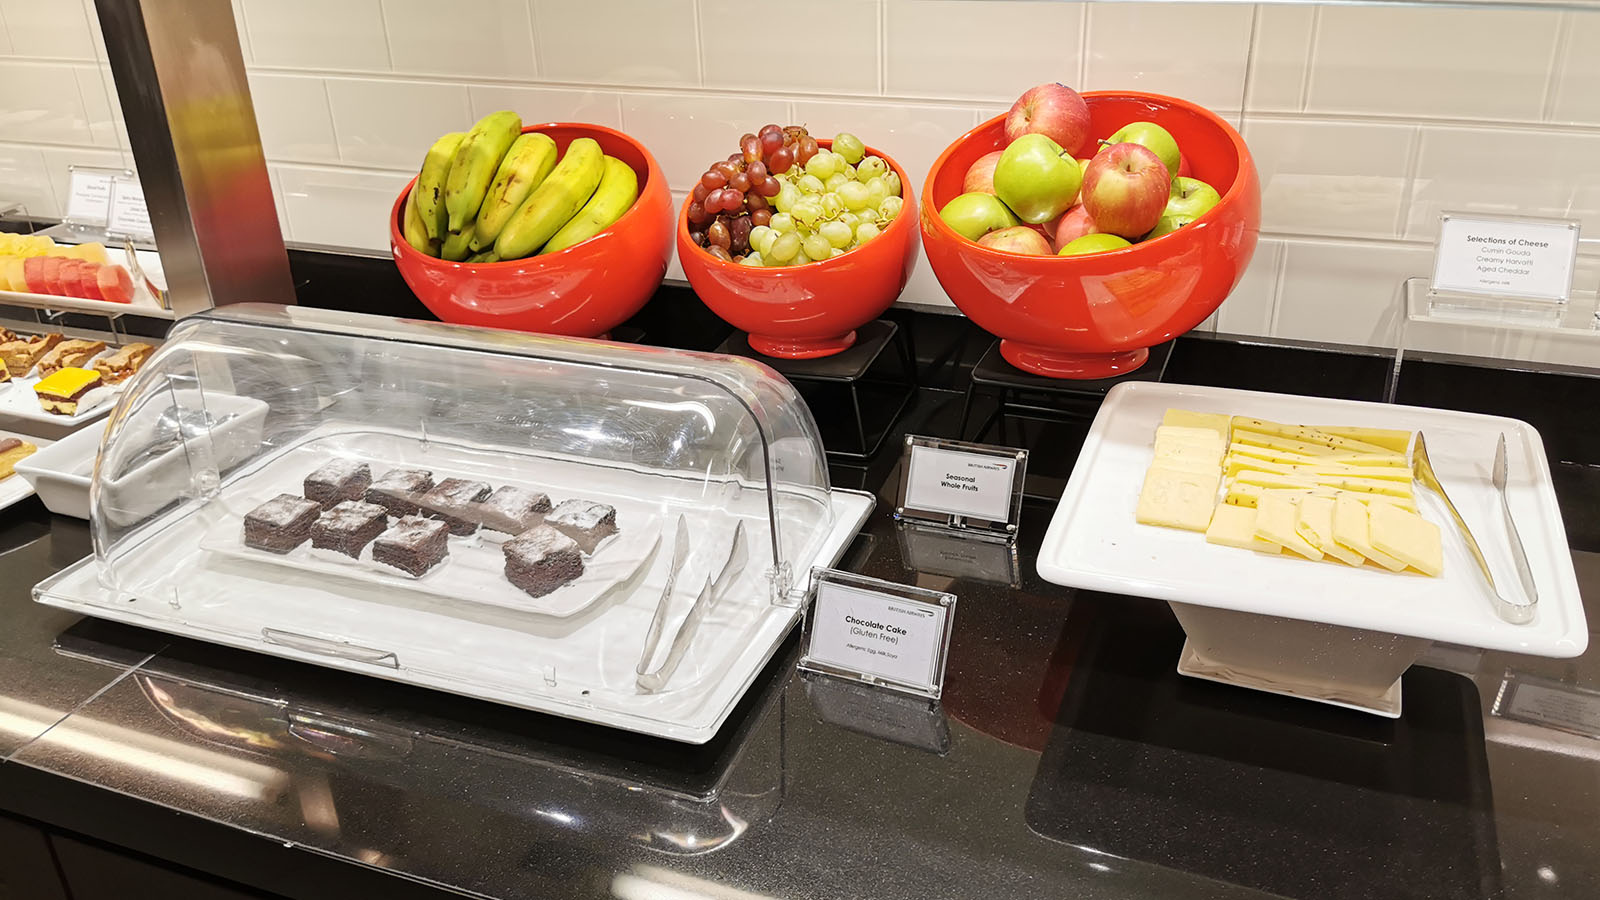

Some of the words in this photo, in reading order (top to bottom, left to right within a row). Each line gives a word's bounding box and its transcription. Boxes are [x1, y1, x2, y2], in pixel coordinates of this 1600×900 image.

[1467, 235, 1506, 245] Selections
[1518, 239, 1549, 248] Cheese
[1505, 248, 1532, 257] Gouda
[1476, 255, 1504, 265] Creamy
[1476, 265, 1497, 274] Aged
[1498, 266, 1530, 275] Cheddar
[946, 473, 976, 483] Seasonal
[940, 480, 961, 489] Whole
[962, 483, 979, 492] Fruits
[888, 606, 906, 614] BRITISH
[845, 615, 885, 631] Chocolate
[885, 624, 907, 636] Cake
[850, 626, 878, 639] (Gluten
[879, 633, 899, 646] Free)
